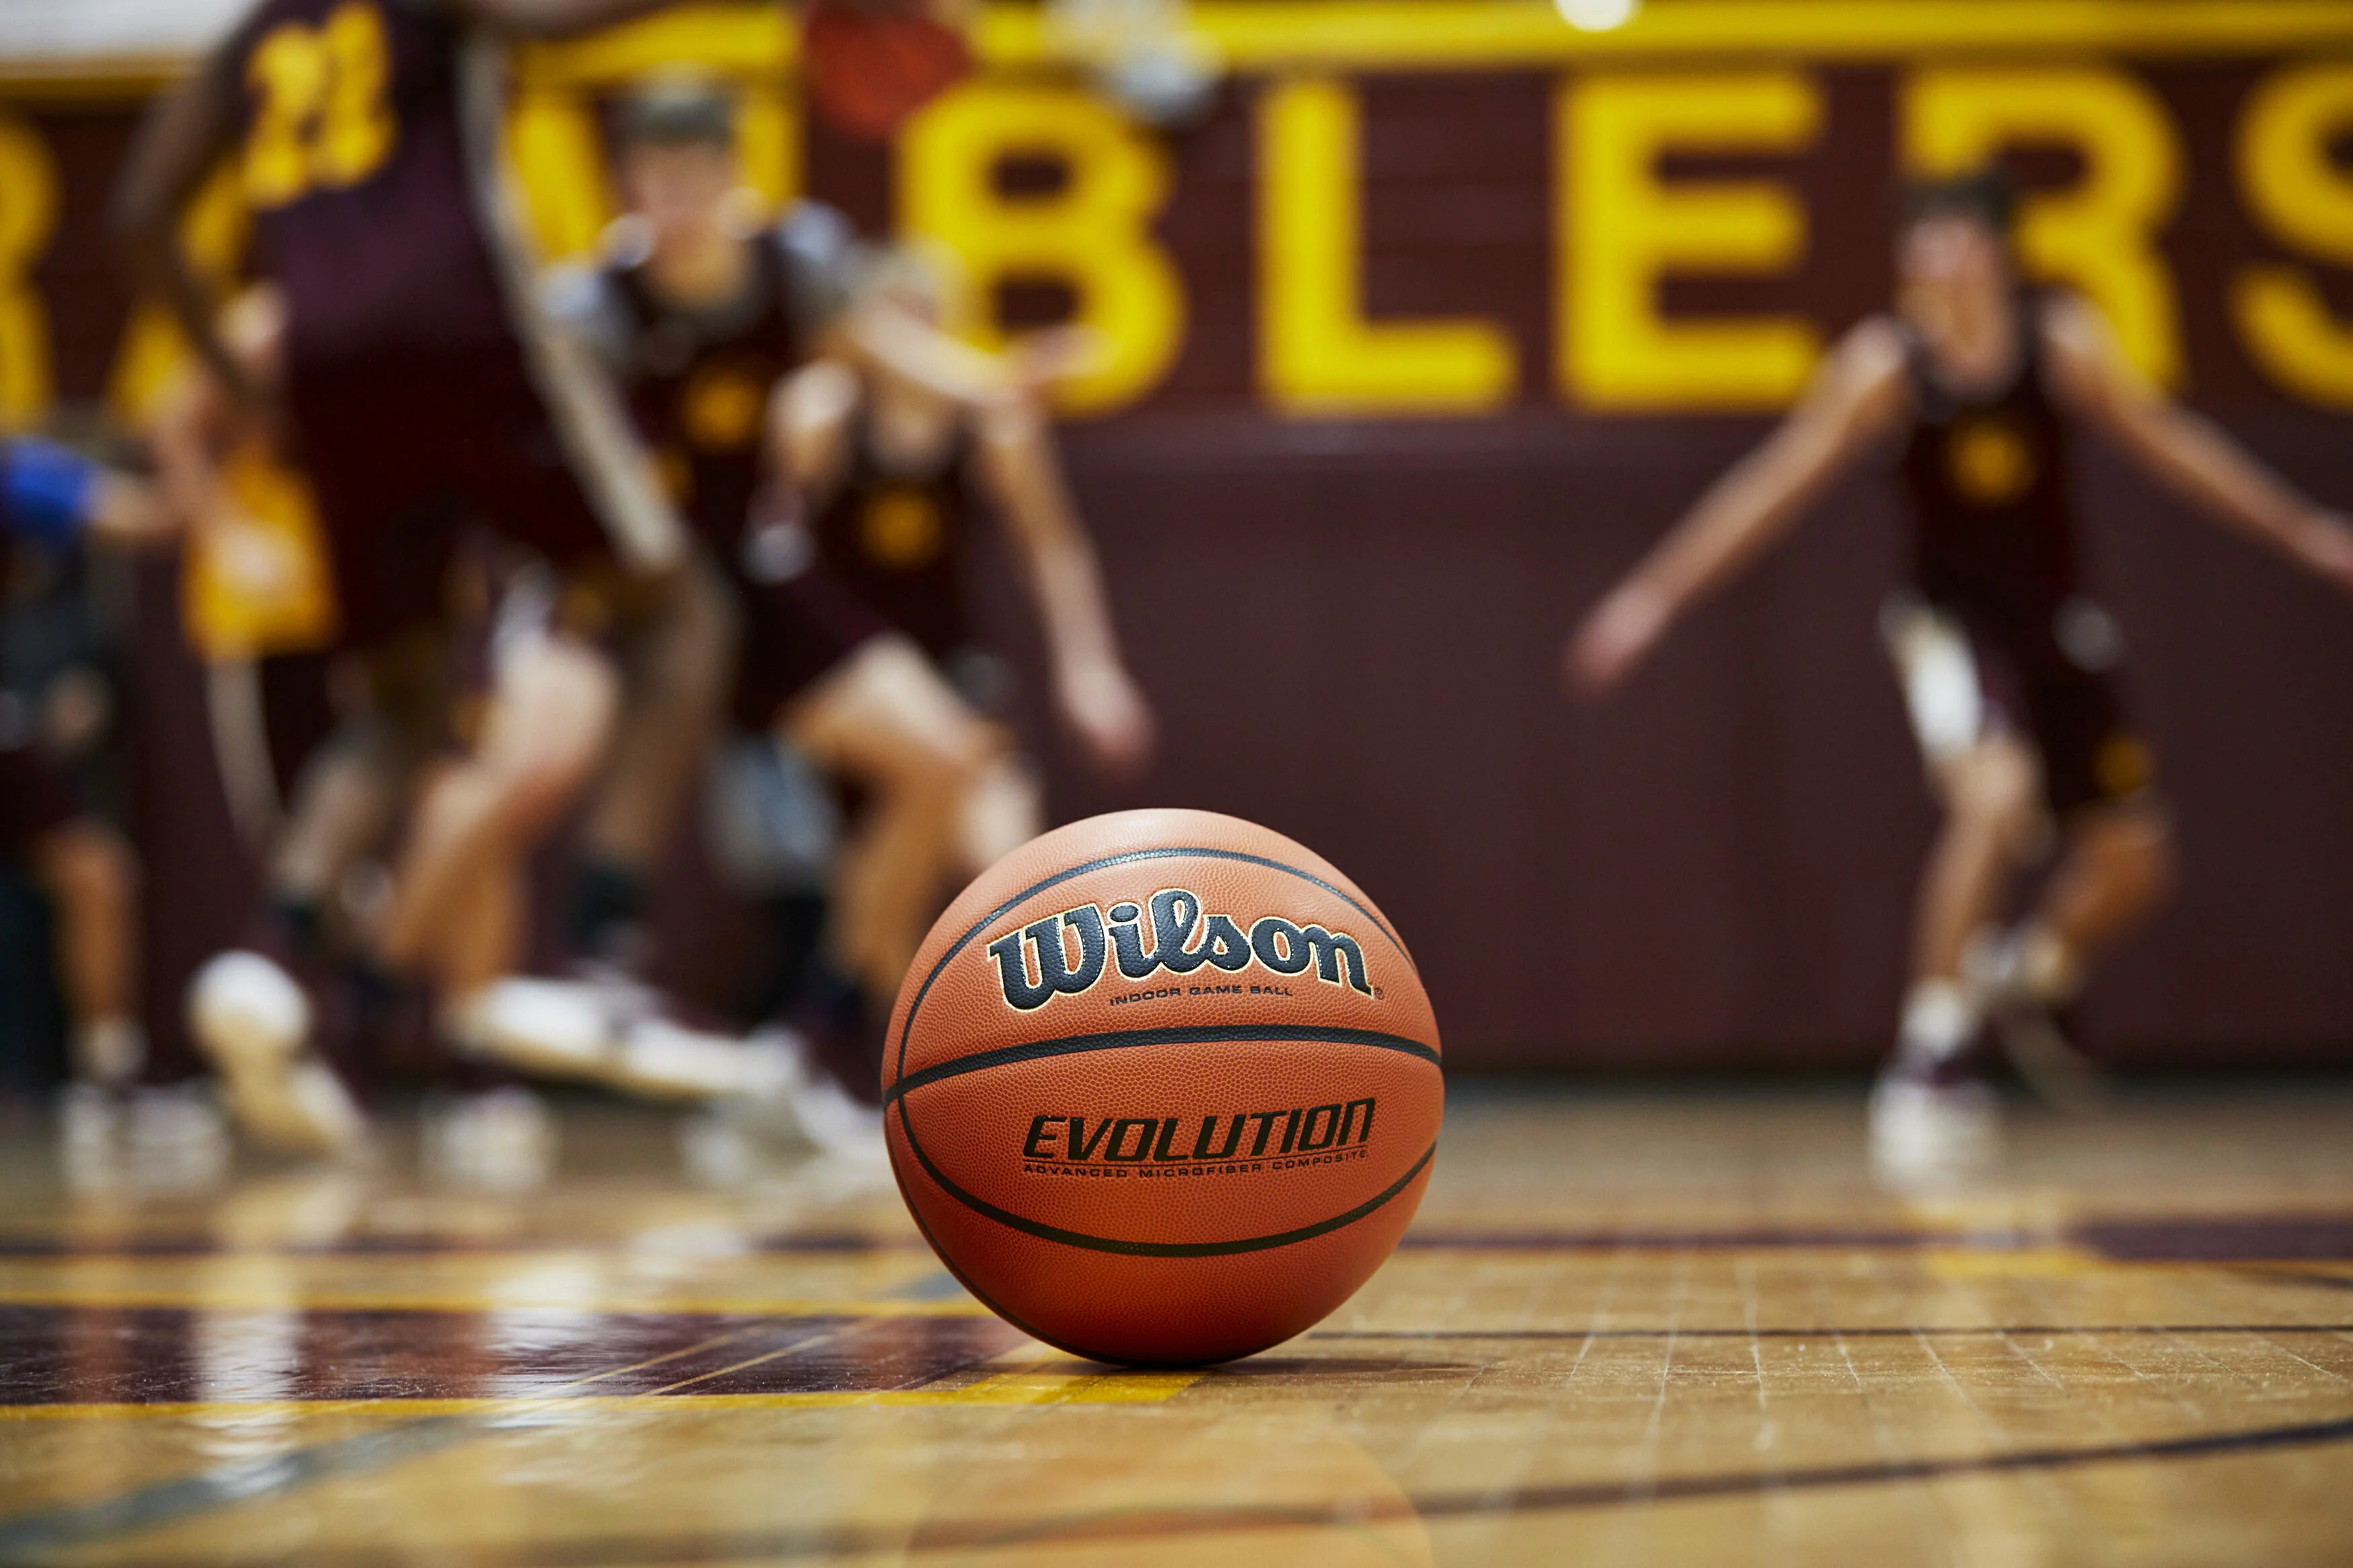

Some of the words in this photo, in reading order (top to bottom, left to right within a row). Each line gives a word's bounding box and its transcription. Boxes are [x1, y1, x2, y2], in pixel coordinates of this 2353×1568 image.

[0, 62, 2353, 425] BLERS
[986, 888, 1373, 1012] Wilson
[1109, 987, 1181, 1007] INDOOR
[1189, 985, 1242, 996] GAME
[1249, 985, 1294, 997] BALL
[1022, 1096, 1376, 1162] EVOLUTION
[1023, 1164, 1128, 1178] ADVANCED
[1139, 1163, 1262, 1178] MICROFIBER
[1272, 1149, 1367, 1170] COMPOSITE
